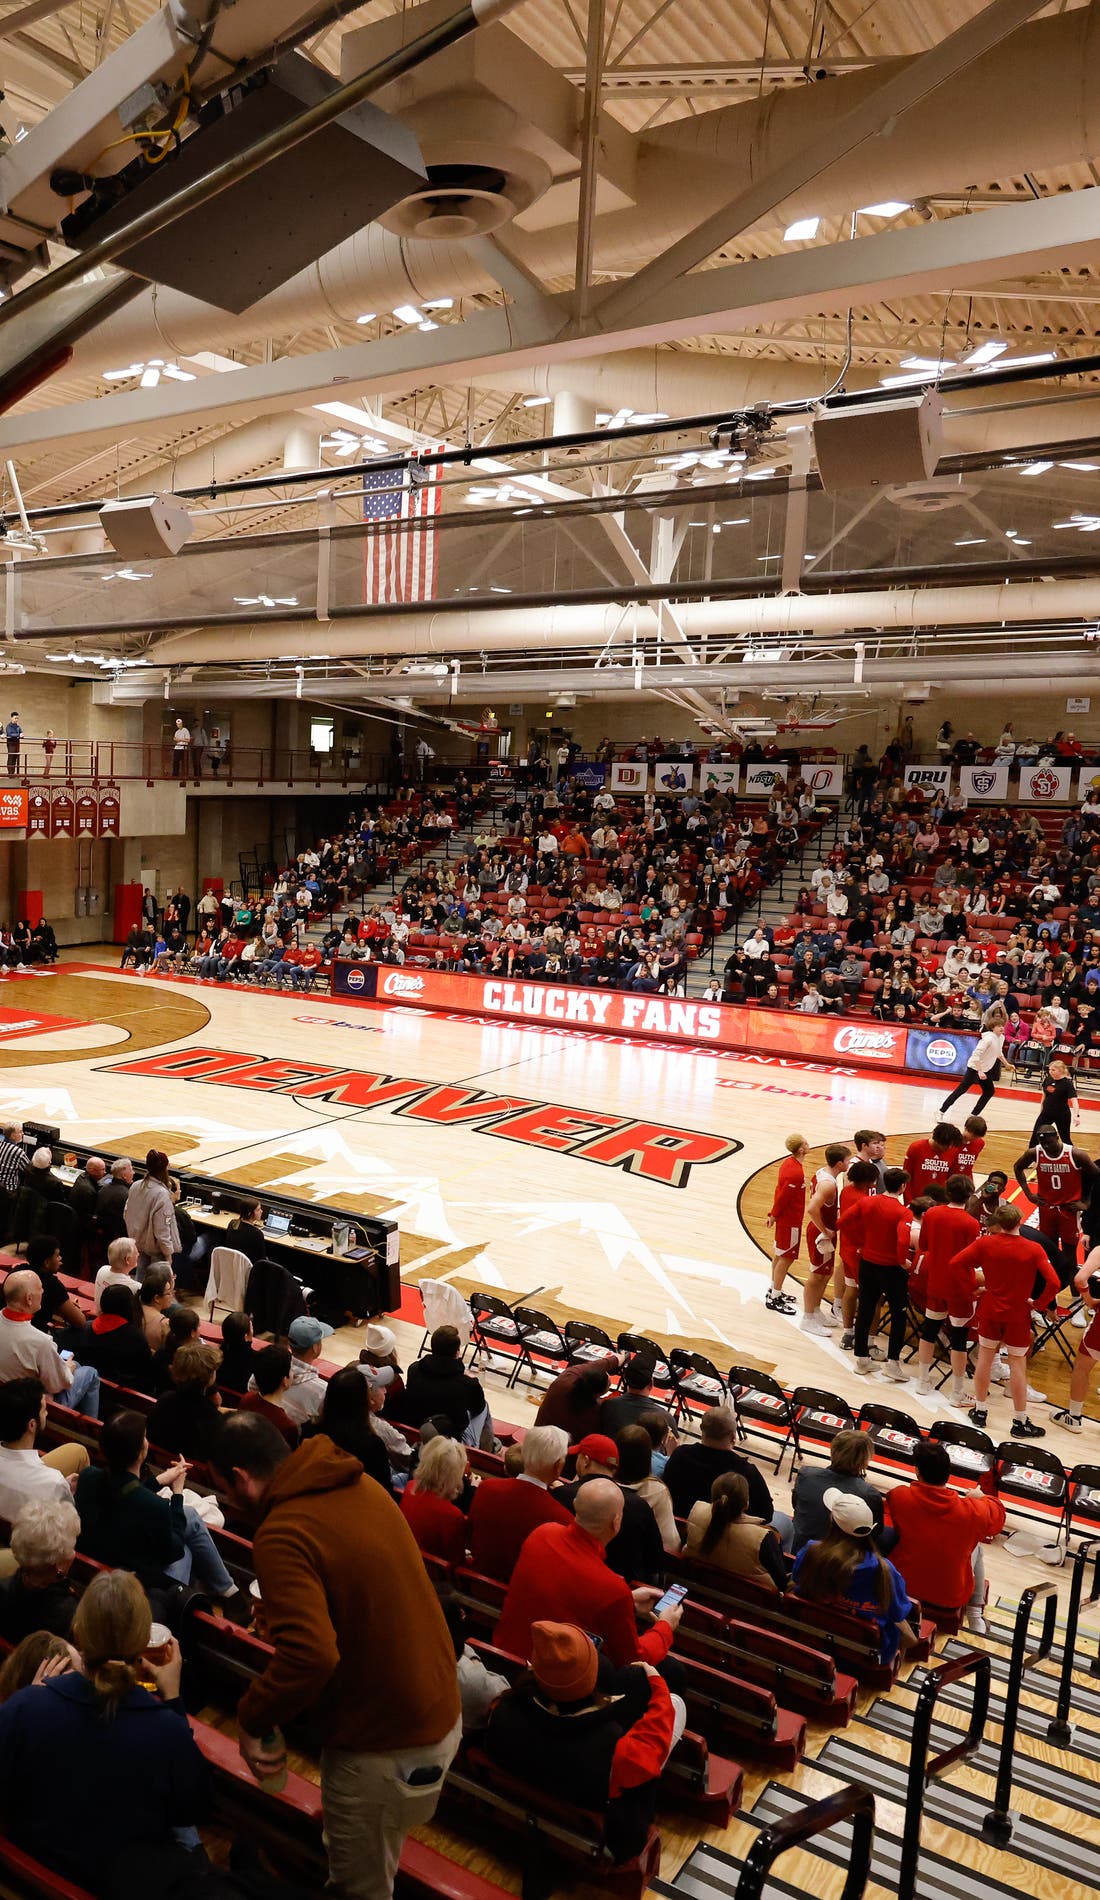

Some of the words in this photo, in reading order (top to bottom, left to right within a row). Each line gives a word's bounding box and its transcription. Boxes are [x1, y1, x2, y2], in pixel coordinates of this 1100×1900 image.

[748, 775, 773, 784] NDSU
[0, 806, 19, 816] vas
[384, 972, 426, 995] Cane's
[483, 981, 612, 1024] CLUCKY
[621, 997, 721, 1039] FANS
[446, 1014, 645, 1048] UNIVERSITY
[645, 1042, 686, 1051] OF
[687, 1049, 858, 1077] DENVER
[833, 1026, 897, 1053] Cane's
[928, 1048, 955, 1057] PEPSI
[90, 1046, 744, 1189] DENVER
[921, 1163, 950, 1173] DAKOTA
[924, 1158, 949, 1168] SOUTH
[1040, 1163, 1053, 1173] SOUTH
[1054, 1163, 1071, 1173] DAKOTA
[1051, 1174, 1062, 1190] 0
